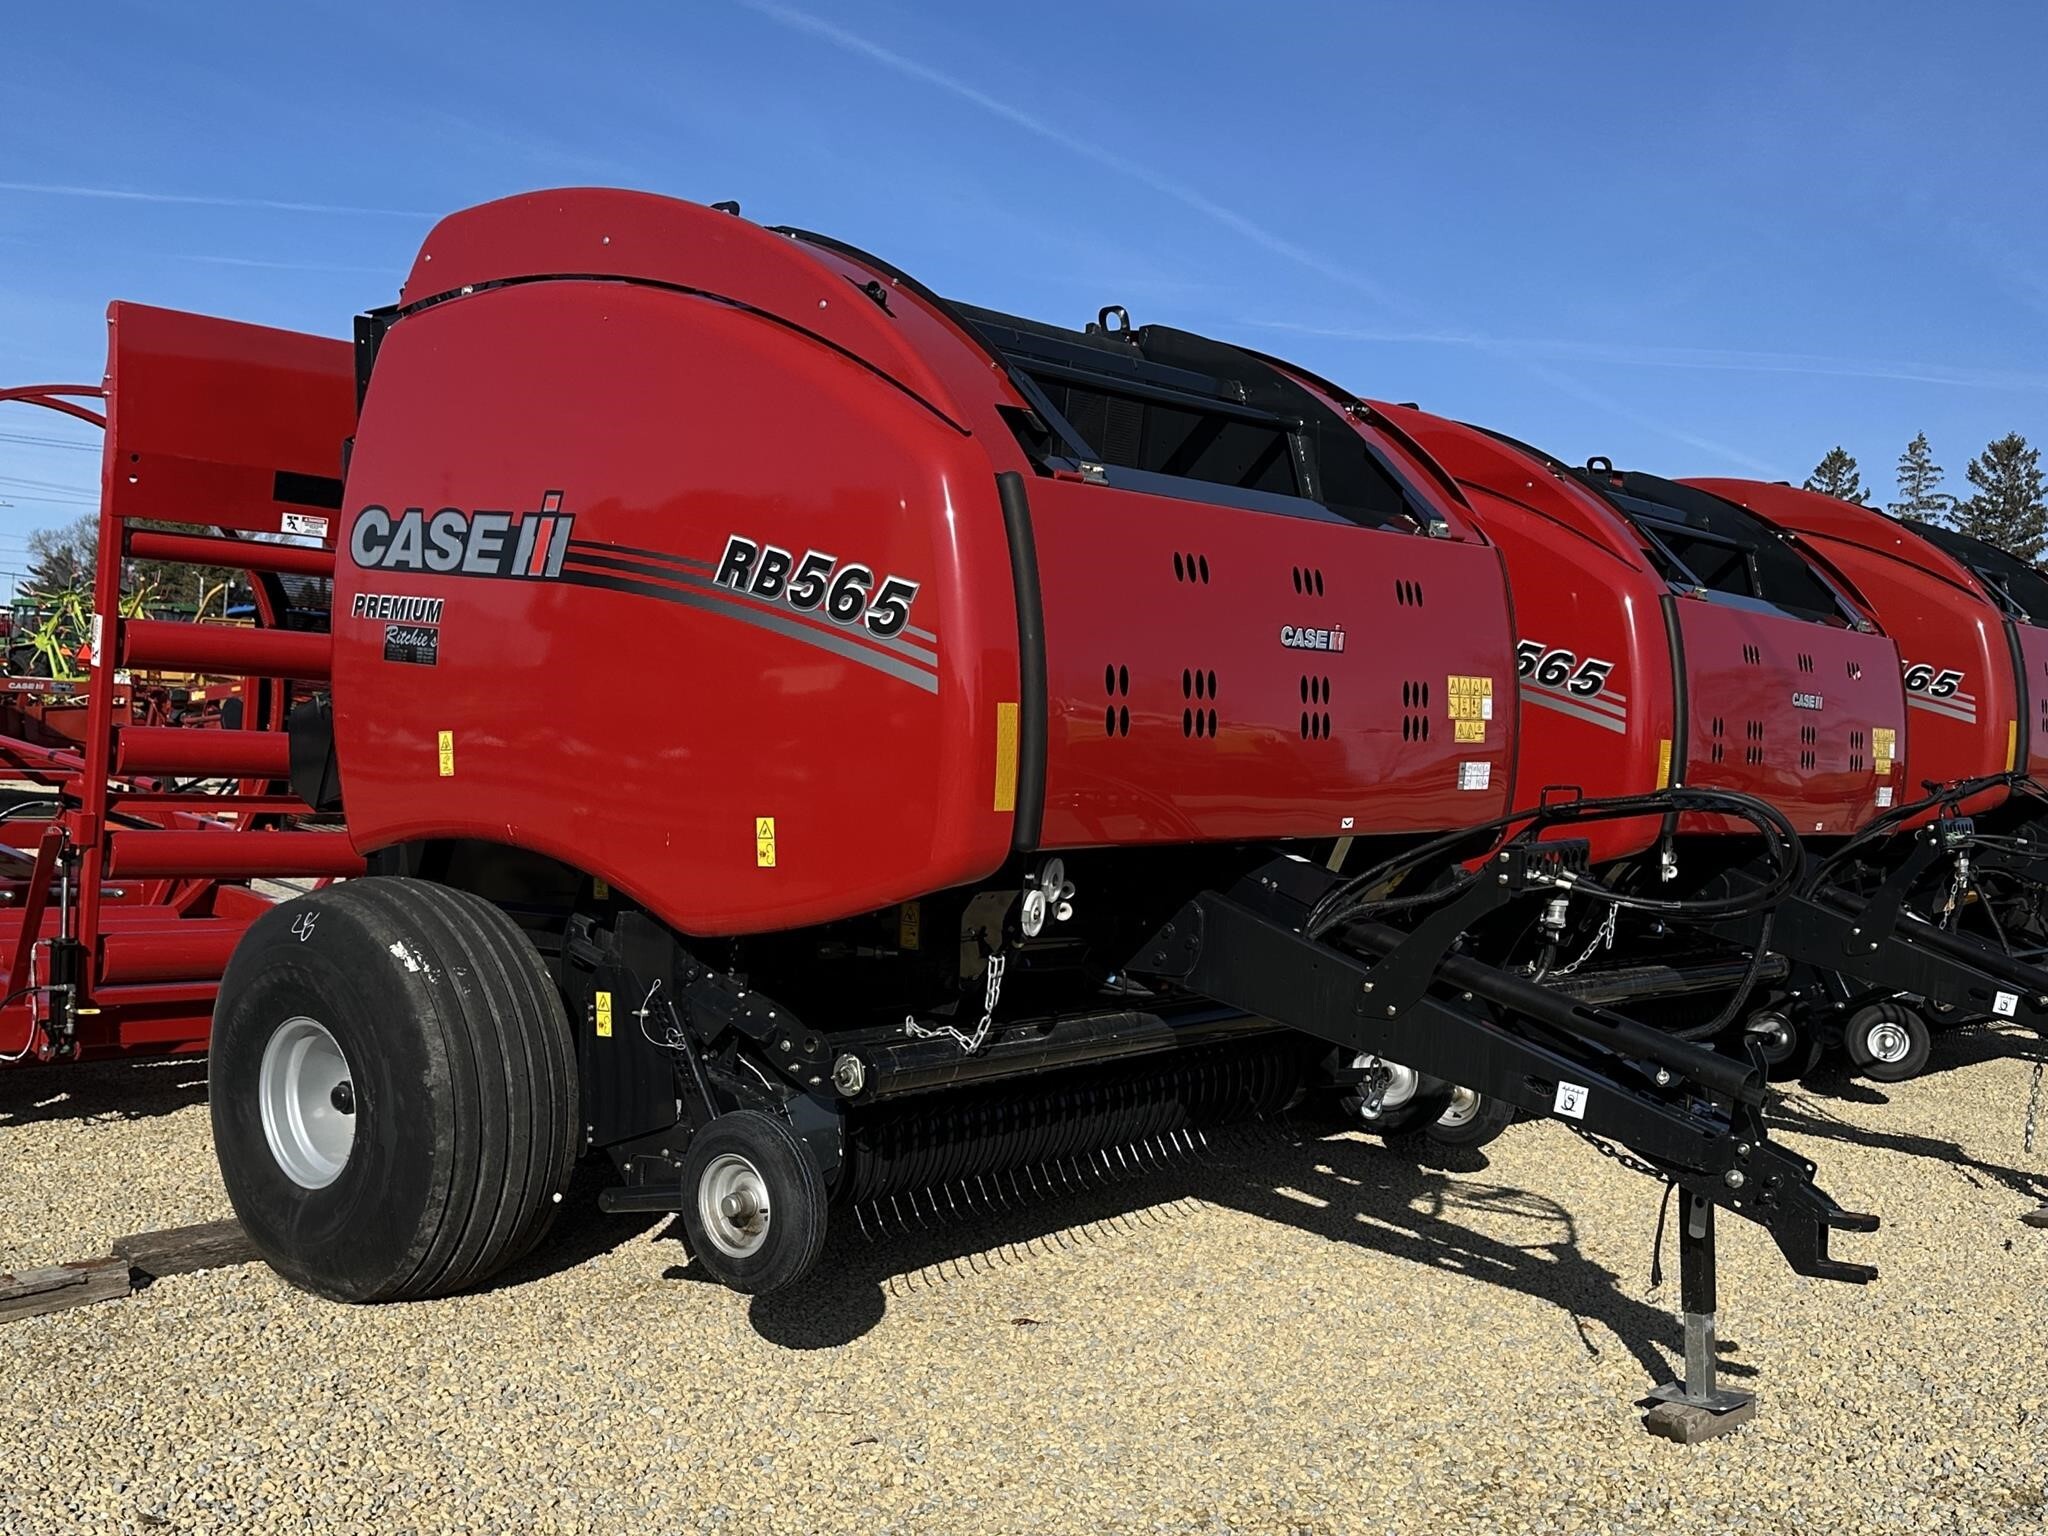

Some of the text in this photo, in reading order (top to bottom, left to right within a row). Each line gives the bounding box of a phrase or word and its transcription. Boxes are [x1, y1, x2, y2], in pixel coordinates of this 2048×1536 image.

[350, 507, 511, 575] CASE
[713, 534, 920, 640] RB565
[351, 592, 445, 624] PREMIUM
[385, 625, 439, 648] Ritchie's
[1280, 625, 1328, 649] CASE
[8, 682, 35, 690] CASE
[1902, 659, 1965, 699] 65
[1792, 692, 1815, 709] CASE
